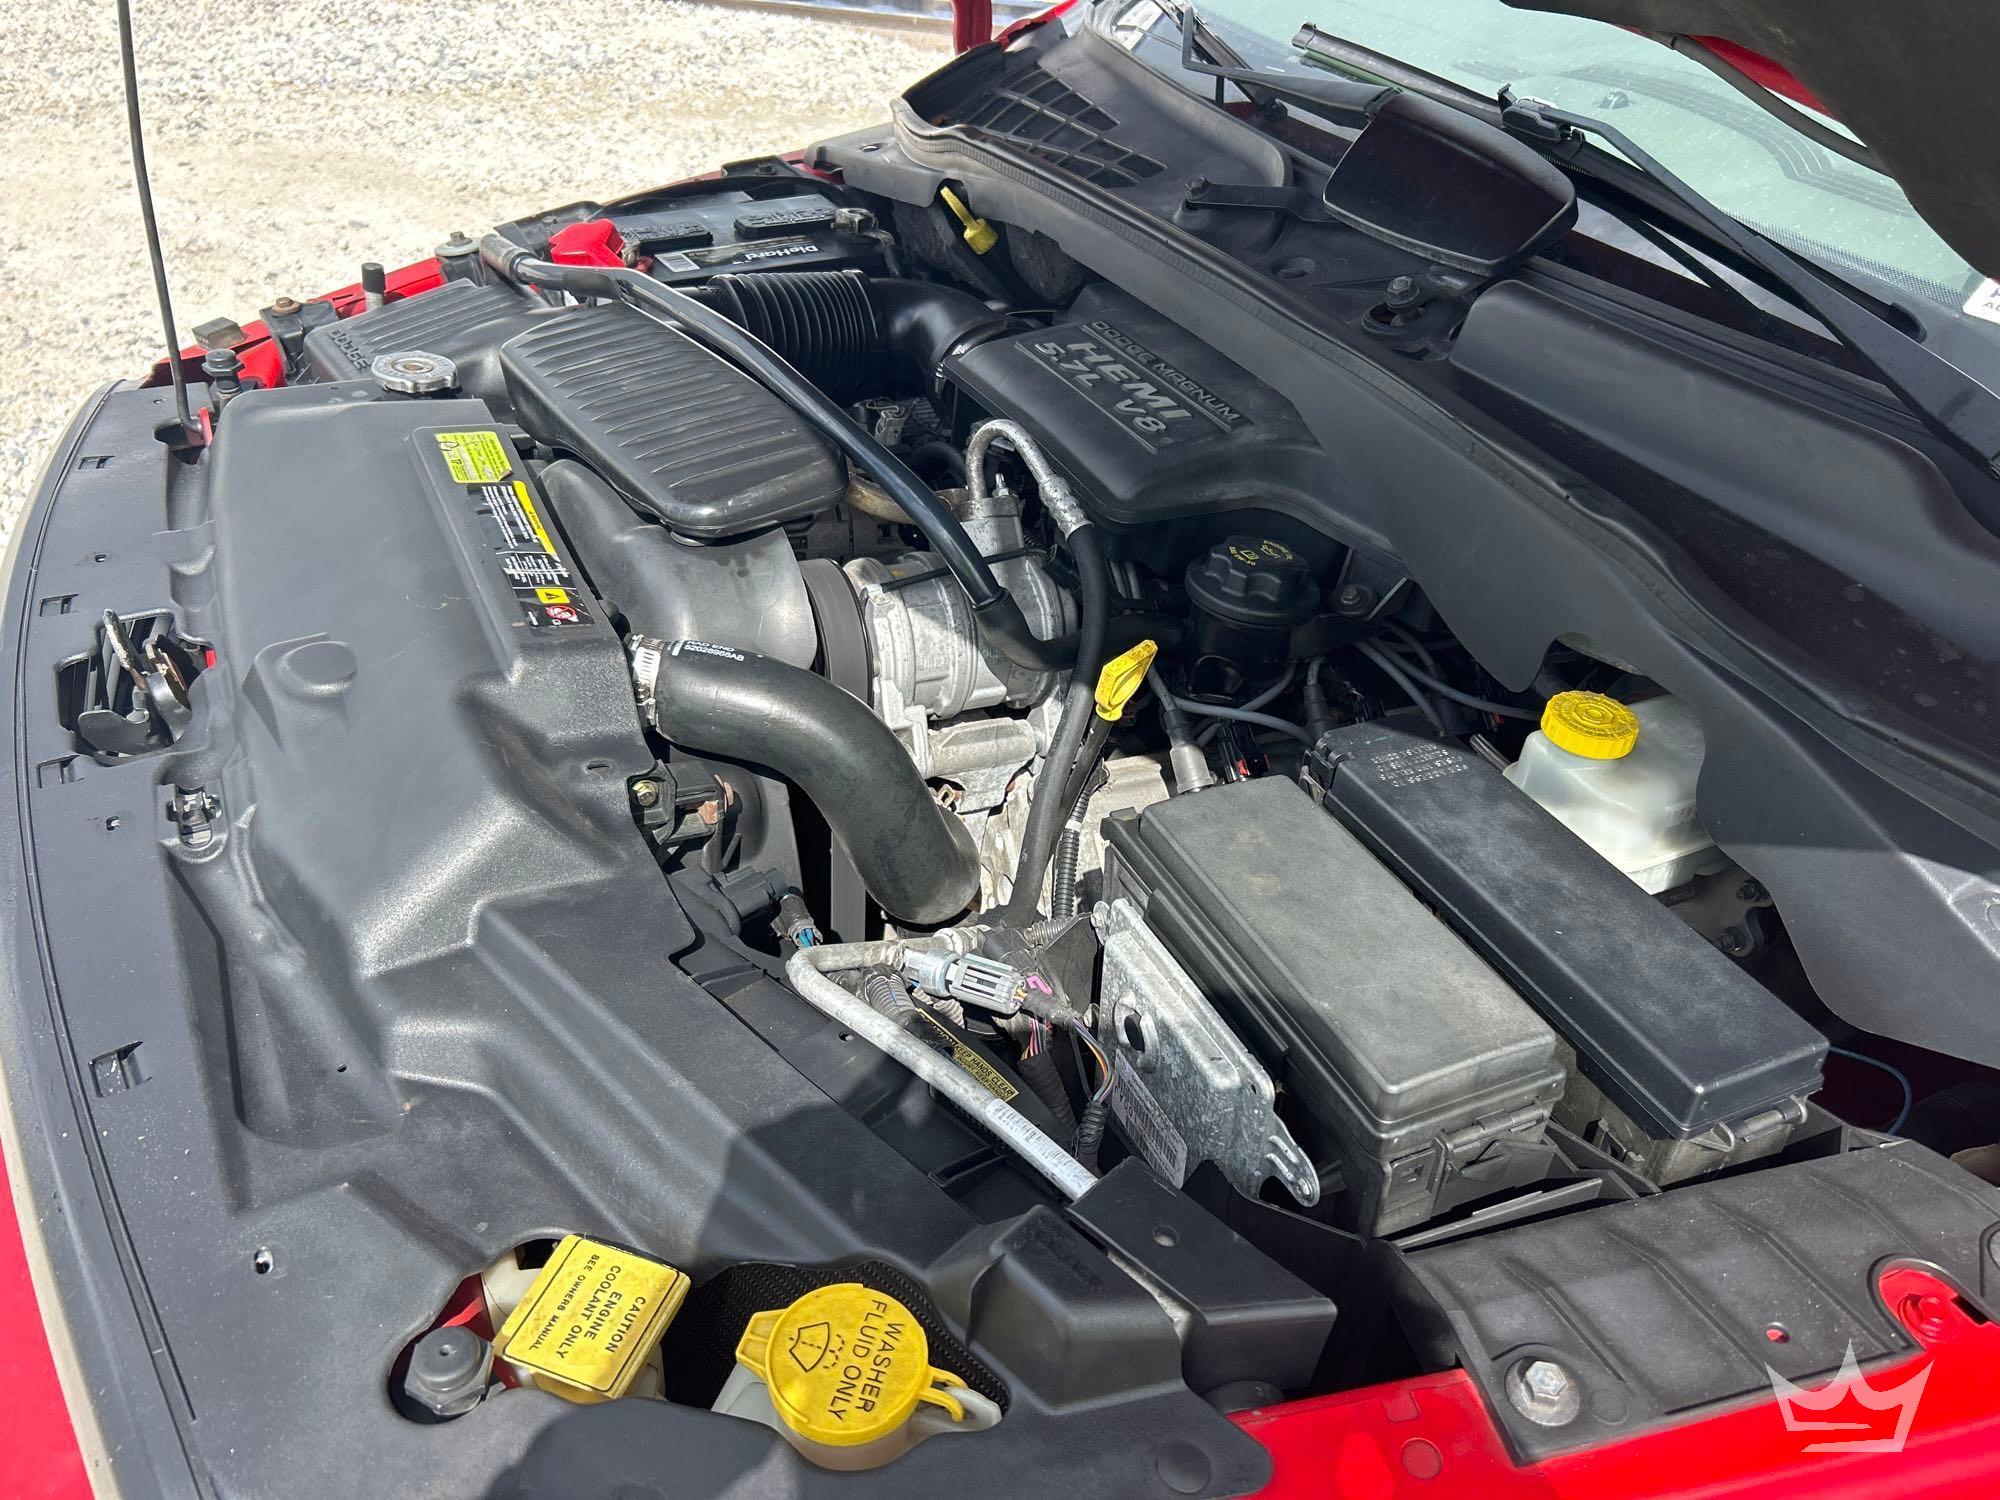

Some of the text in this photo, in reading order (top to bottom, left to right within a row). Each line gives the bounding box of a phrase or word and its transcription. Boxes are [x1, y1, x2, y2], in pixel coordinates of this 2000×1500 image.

[745, 245, 819, 260] DieHard
[1034, 342, 1167, 432] 5.7L V8
[1067, 342, 1192, 419] HEMI
[1092, 321, 1240, 421] DODGE MAGNUM
[711, 644, 735, 652] END
[955, 1044, 972, 1058] KEEP
[971, 1057, 993, 1077] HANDS
[991, 1076, 1014, 1096] CLEAR
[529, 1314, 560, 1350] MANUAL
[556, 1265, 621, 1358] COOLANT ONLY
[584, 1291, 622, 1340] ENGINE
[605, 1296, 646, 1353] CAUTION
[828, 1300, 888, 1421] FLUID ONLY
[855, 1322, 904, 1413] WASHER
